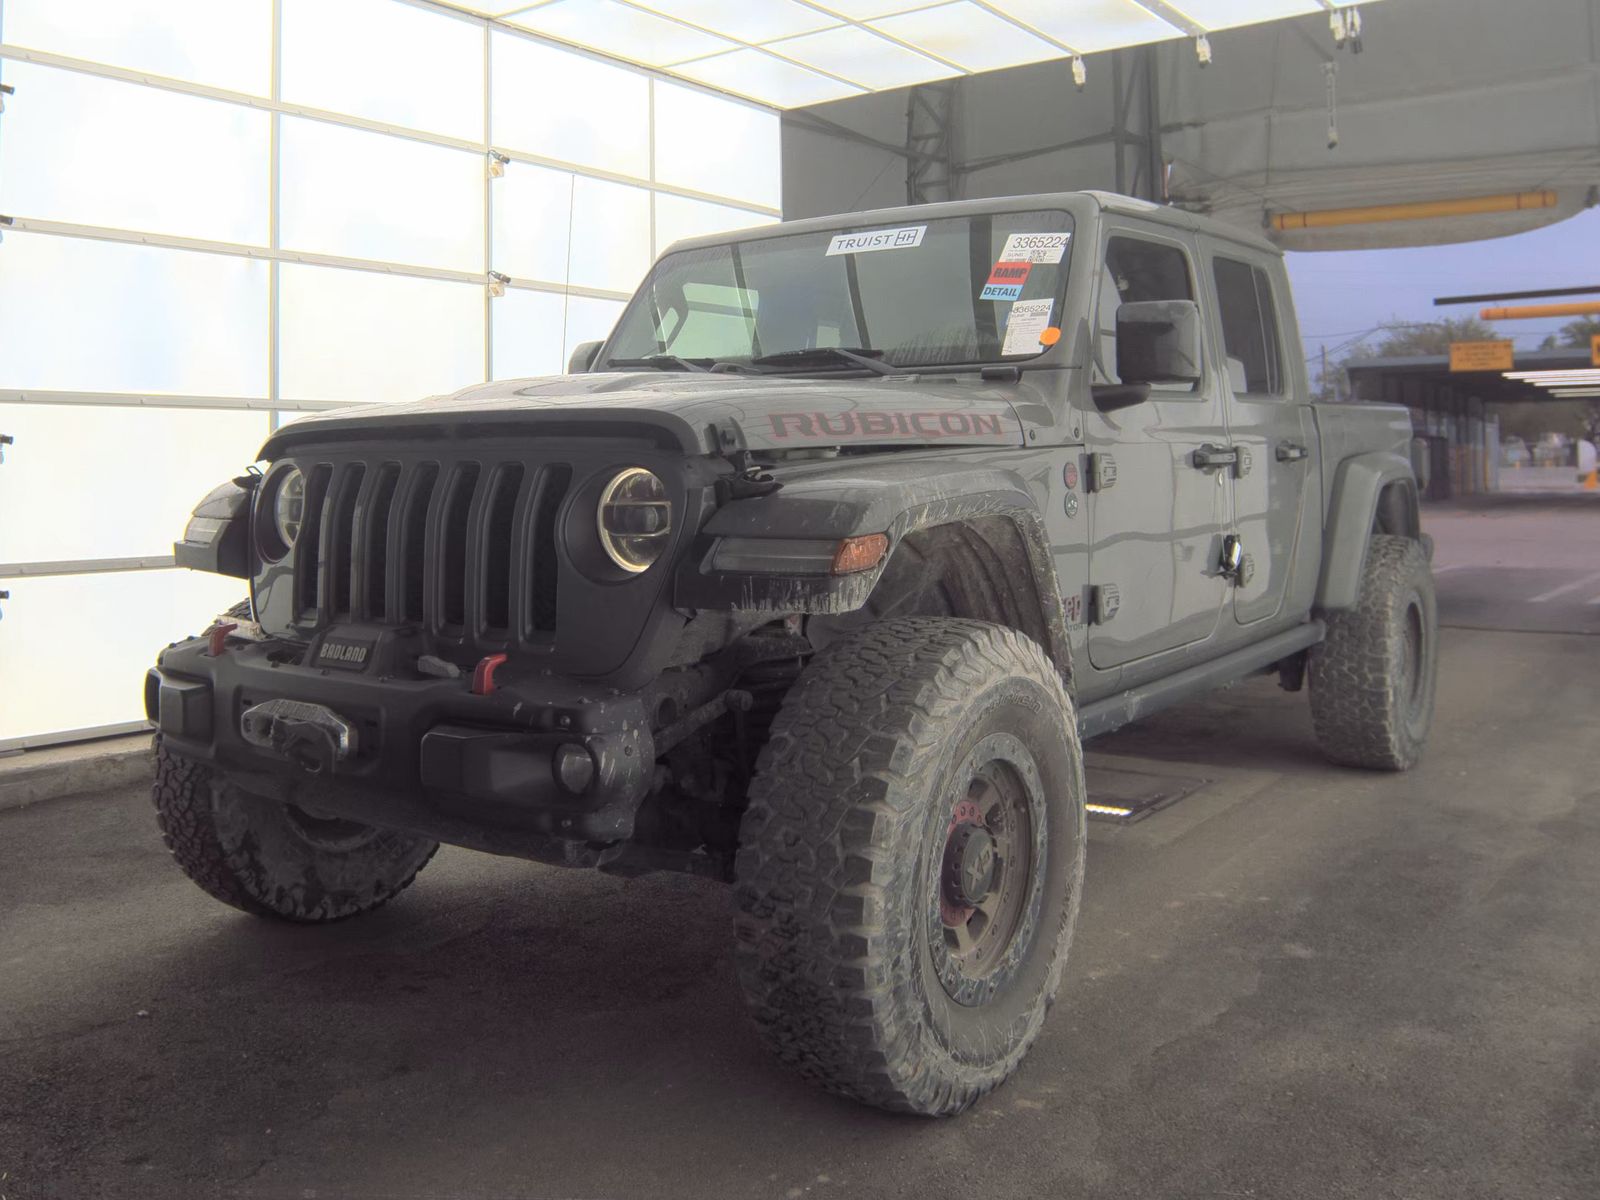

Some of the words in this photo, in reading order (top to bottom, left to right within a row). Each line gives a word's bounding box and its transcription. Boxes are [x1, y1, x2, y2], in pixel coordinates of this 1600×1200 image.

[836, 233, 893, 249] TRUIST
[1012, 236, 1069, 249] 3365224
[993, 267, 1028, 278] RAMP
[983, 286, 1018, 297] DETAIL
[768, 411, 1003, 438] RUBICON
[320, 643, 367, 662] BADLAND
